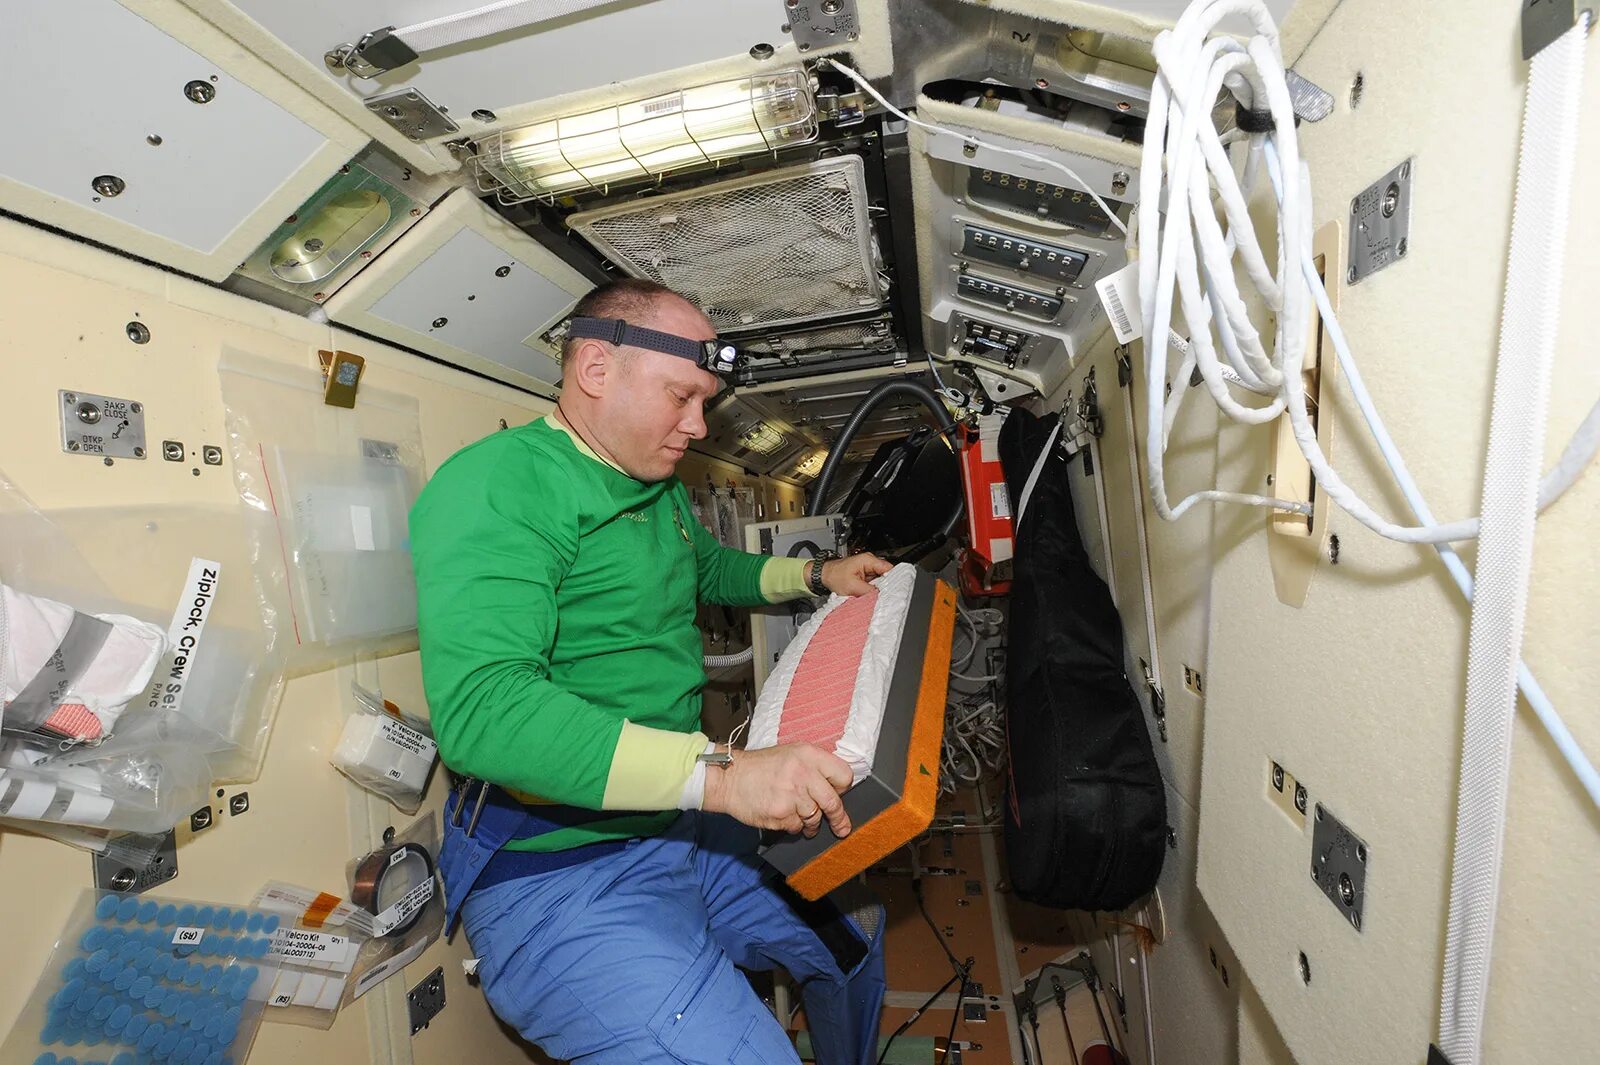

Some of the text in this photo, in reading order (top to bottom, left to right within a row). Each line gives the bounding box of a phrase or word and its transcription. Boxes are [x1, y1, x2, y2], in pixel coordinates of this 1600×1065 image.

[402, 167, 412, 181] 3
[104, 409, 128, 420] CLOSE
[83, 444, 104, 454] OPEN
[182, 567, 217, 631] Ziplock,
[169, 635, 196, 680] Crew
[398, 724, 416, 738] Velcro
[415, 733, 423, 741] Kit
[285, 930, 309, 941] Velcro
[309, 933, 320, 942] Kit
